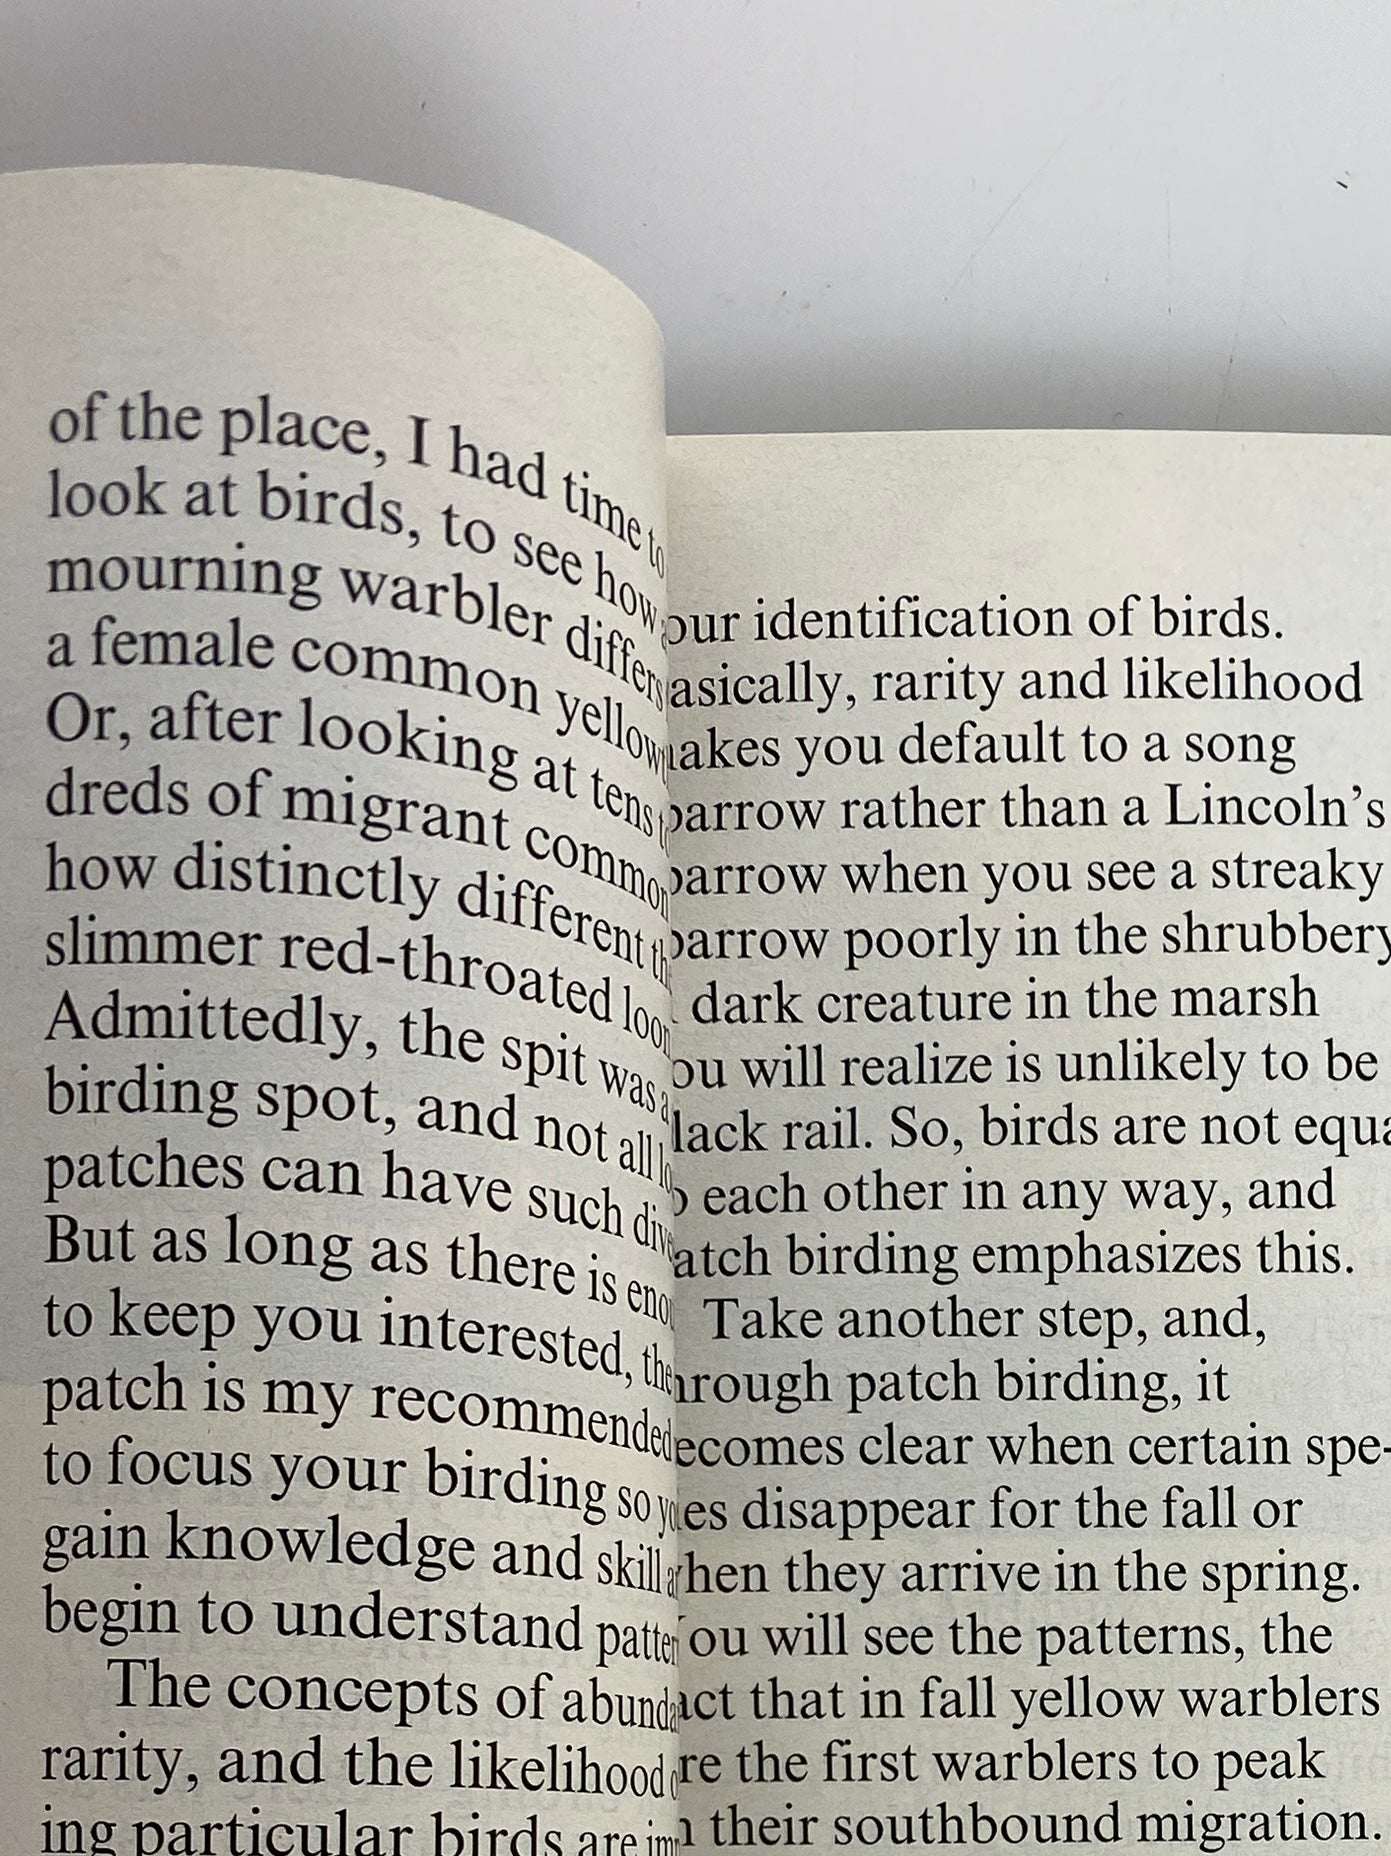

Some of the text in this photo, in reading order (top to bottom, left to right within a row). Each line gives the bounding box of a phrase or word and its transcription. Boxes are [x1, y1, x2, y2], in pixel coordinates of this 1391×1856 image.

[50, 390, 664, 578] of the place, I had time to
[754, 594, 1072, 640] identification
[1089, 594, 1141, 636] of
[1151, 594, 1282, 638] birds.
[47, 690, 653, 837] Or, after looking at tens
[841, 785, 986, 829] rather
[1001, 784, 1108, 827] than
[1123, 797, 1149, 826] a
[692, 973, 1320, 1024] dark creature in the marsh
[44, 989, 655, 1113] Admittedly, the spit was
[44, 1287, 632, 1389] to keep you interested,
[703, 1294, 1265, 1349] Take another step, and,
[107, 1657, 553, 1727] The concepts of
